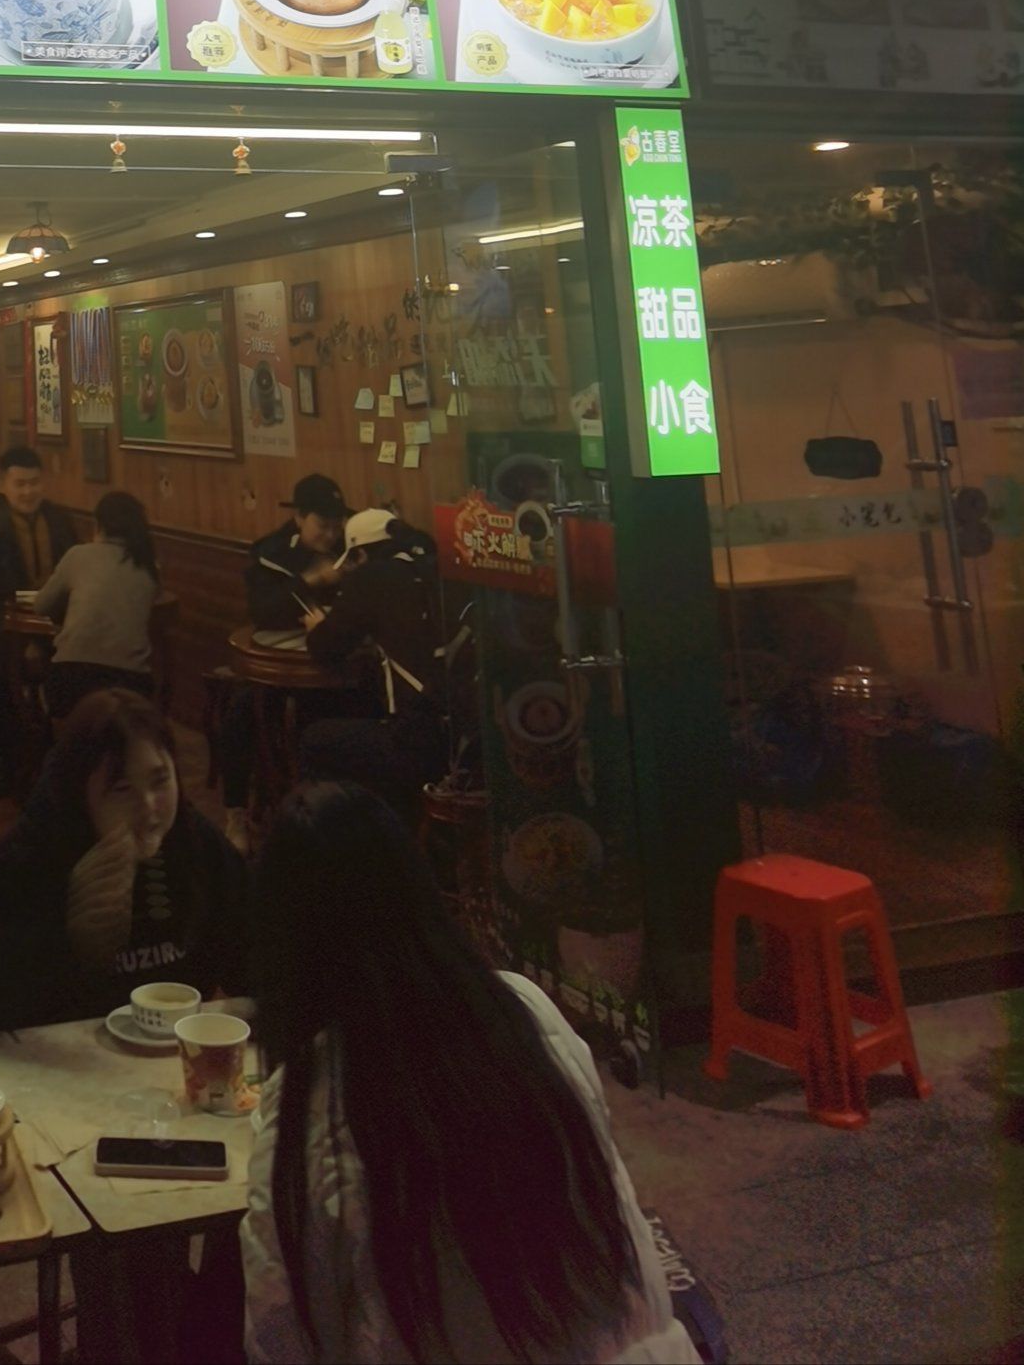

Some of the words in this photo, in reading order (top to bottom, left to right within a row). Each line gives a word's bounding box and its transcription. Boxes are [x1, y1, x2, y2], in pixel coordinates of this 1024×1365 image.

[477, 54, 497, 66] 产品
[629, 195, 692, 247] 凉茶
[638, 287, 702, 339] 甜品
[650, 379, 712, 435] 小食
